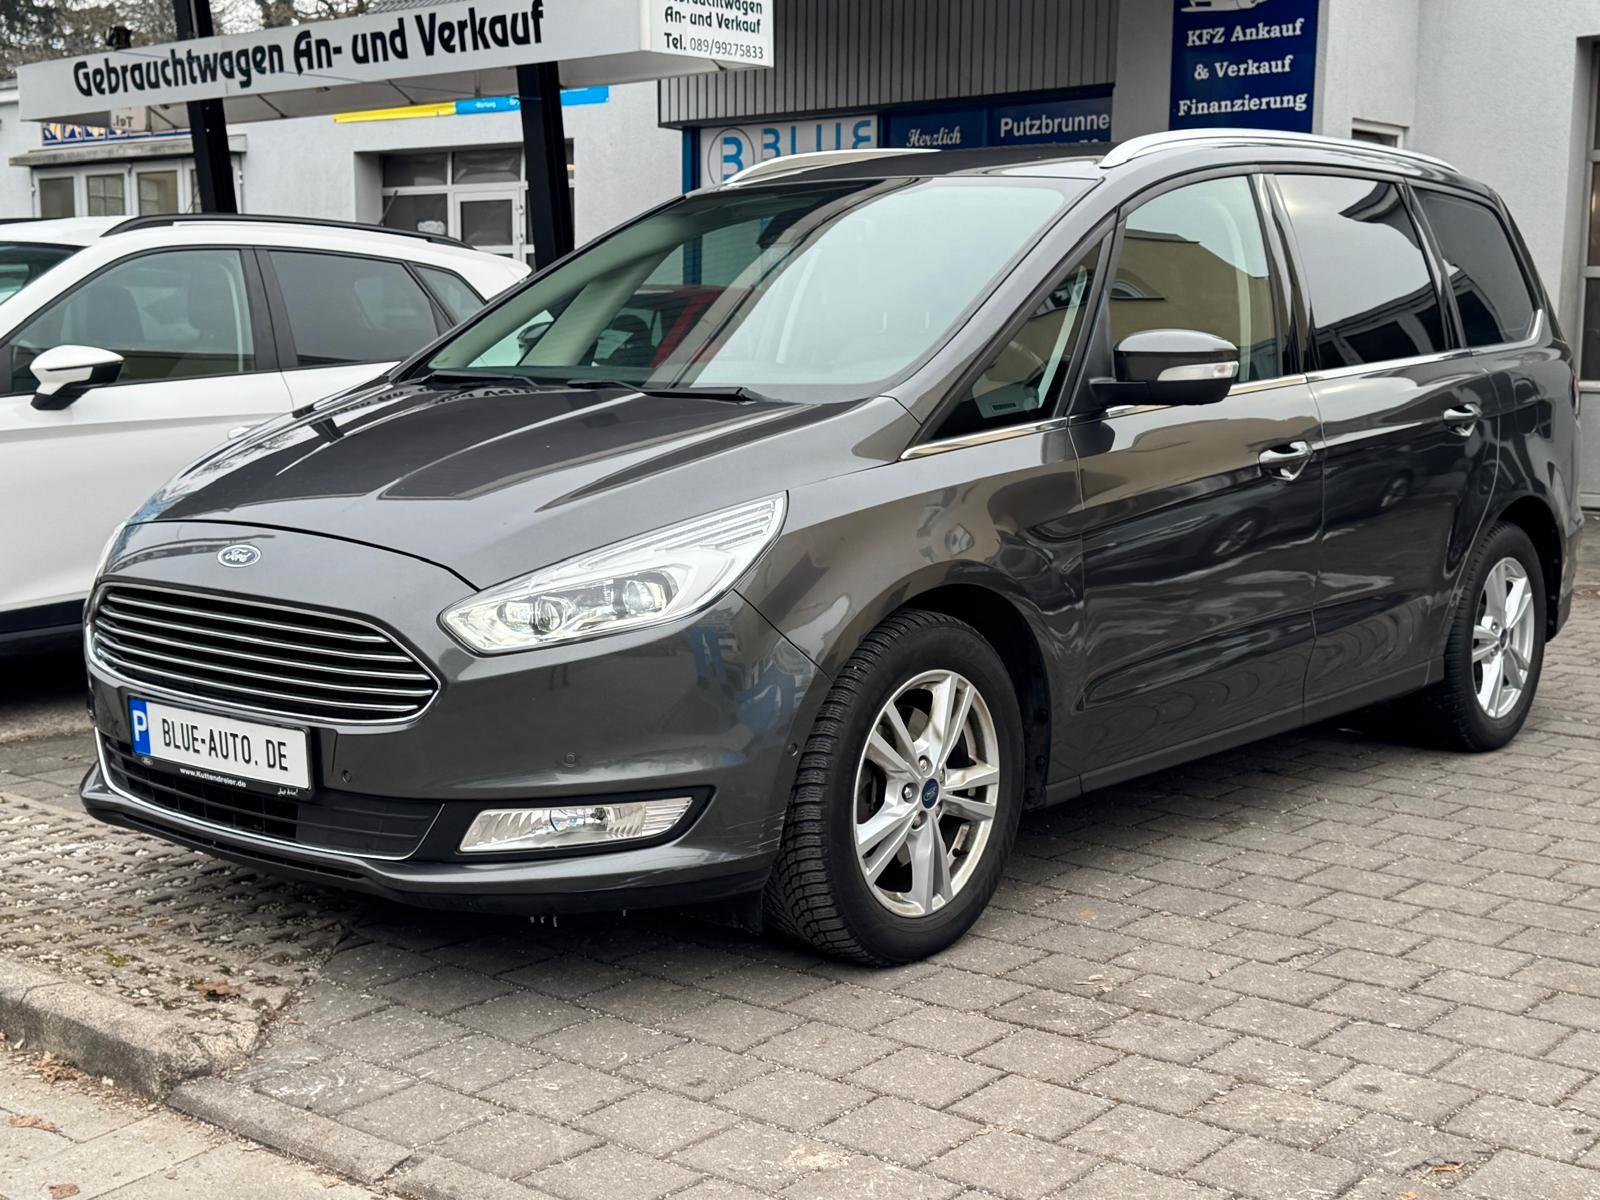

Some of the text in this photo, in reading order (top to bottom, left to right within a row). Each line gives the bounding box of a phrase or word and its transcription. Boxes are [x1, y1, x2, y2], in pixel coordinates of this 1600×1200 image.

[664, 6, 761, 34] An- und Verkauf
[1186, 17, 1305, 47] KFZ Ankauf
[73, 0, 544, 97] Gebrauchtwagen An- und Verkauf
[664, 32, 764, 60] Tel. 089/99275833
[1194, 54, 1294, 80] & Verkauf
[1178, 93, 1308, 117] Finanzierung
[906, 126, 962, 147] Herzlich
